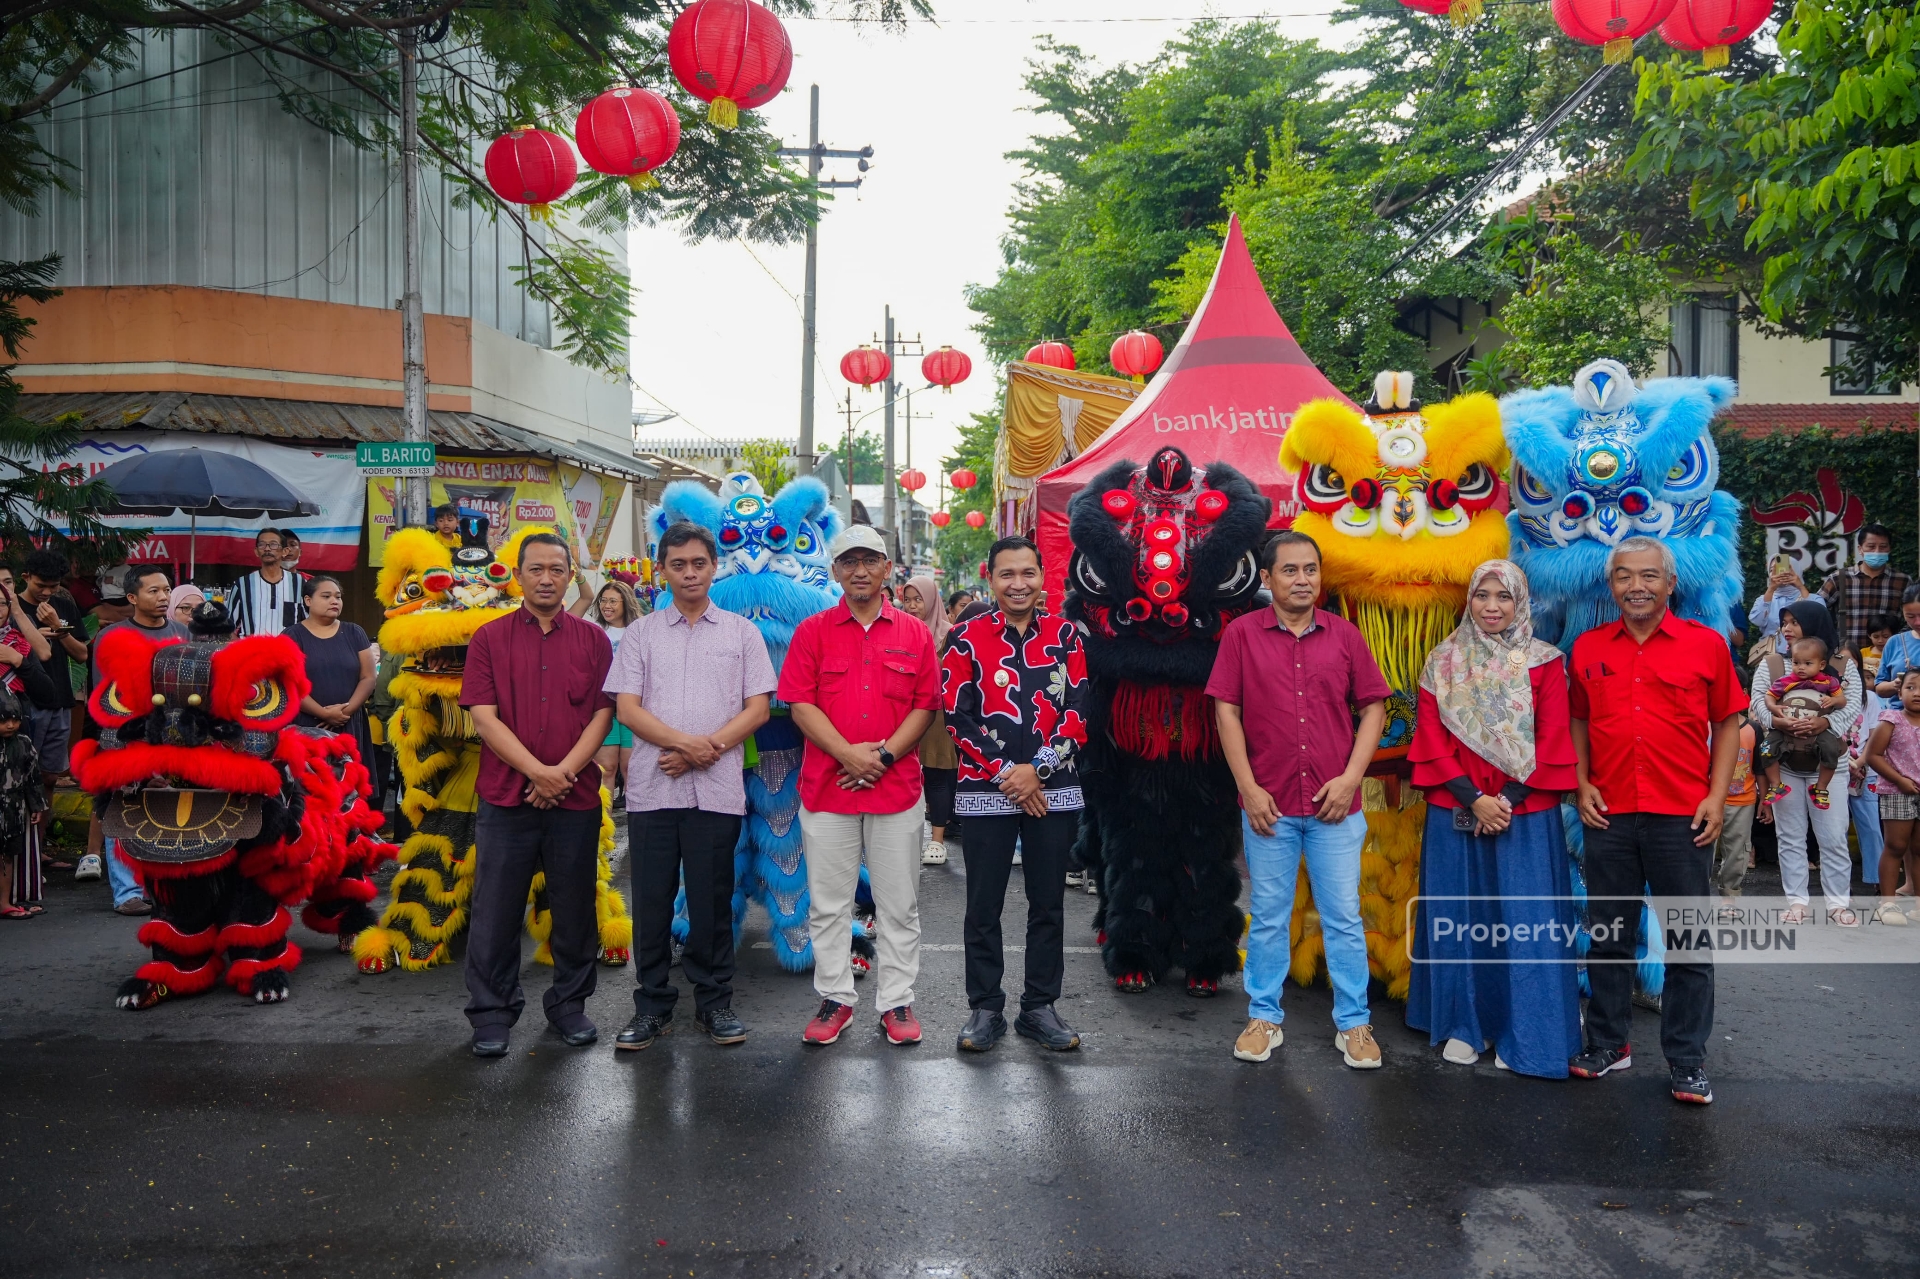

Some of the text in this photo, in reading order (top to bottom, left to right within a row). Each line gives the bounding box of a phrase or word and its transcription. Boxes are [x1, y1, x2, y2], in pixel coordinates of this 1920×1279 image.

[361, 448, 431, 463] JL. BARITO
[435, 461, 477, 478] SNYA
[481, 464, 522, 480] ENAK
[470, 499, 499, 512] MAK
[518, 507, 554, 519] Rp2.000
[575, 499, 592, 519] TOKO
[374, 515, 395, 524] KENTA
[128, 540, 170, 559] RYA
